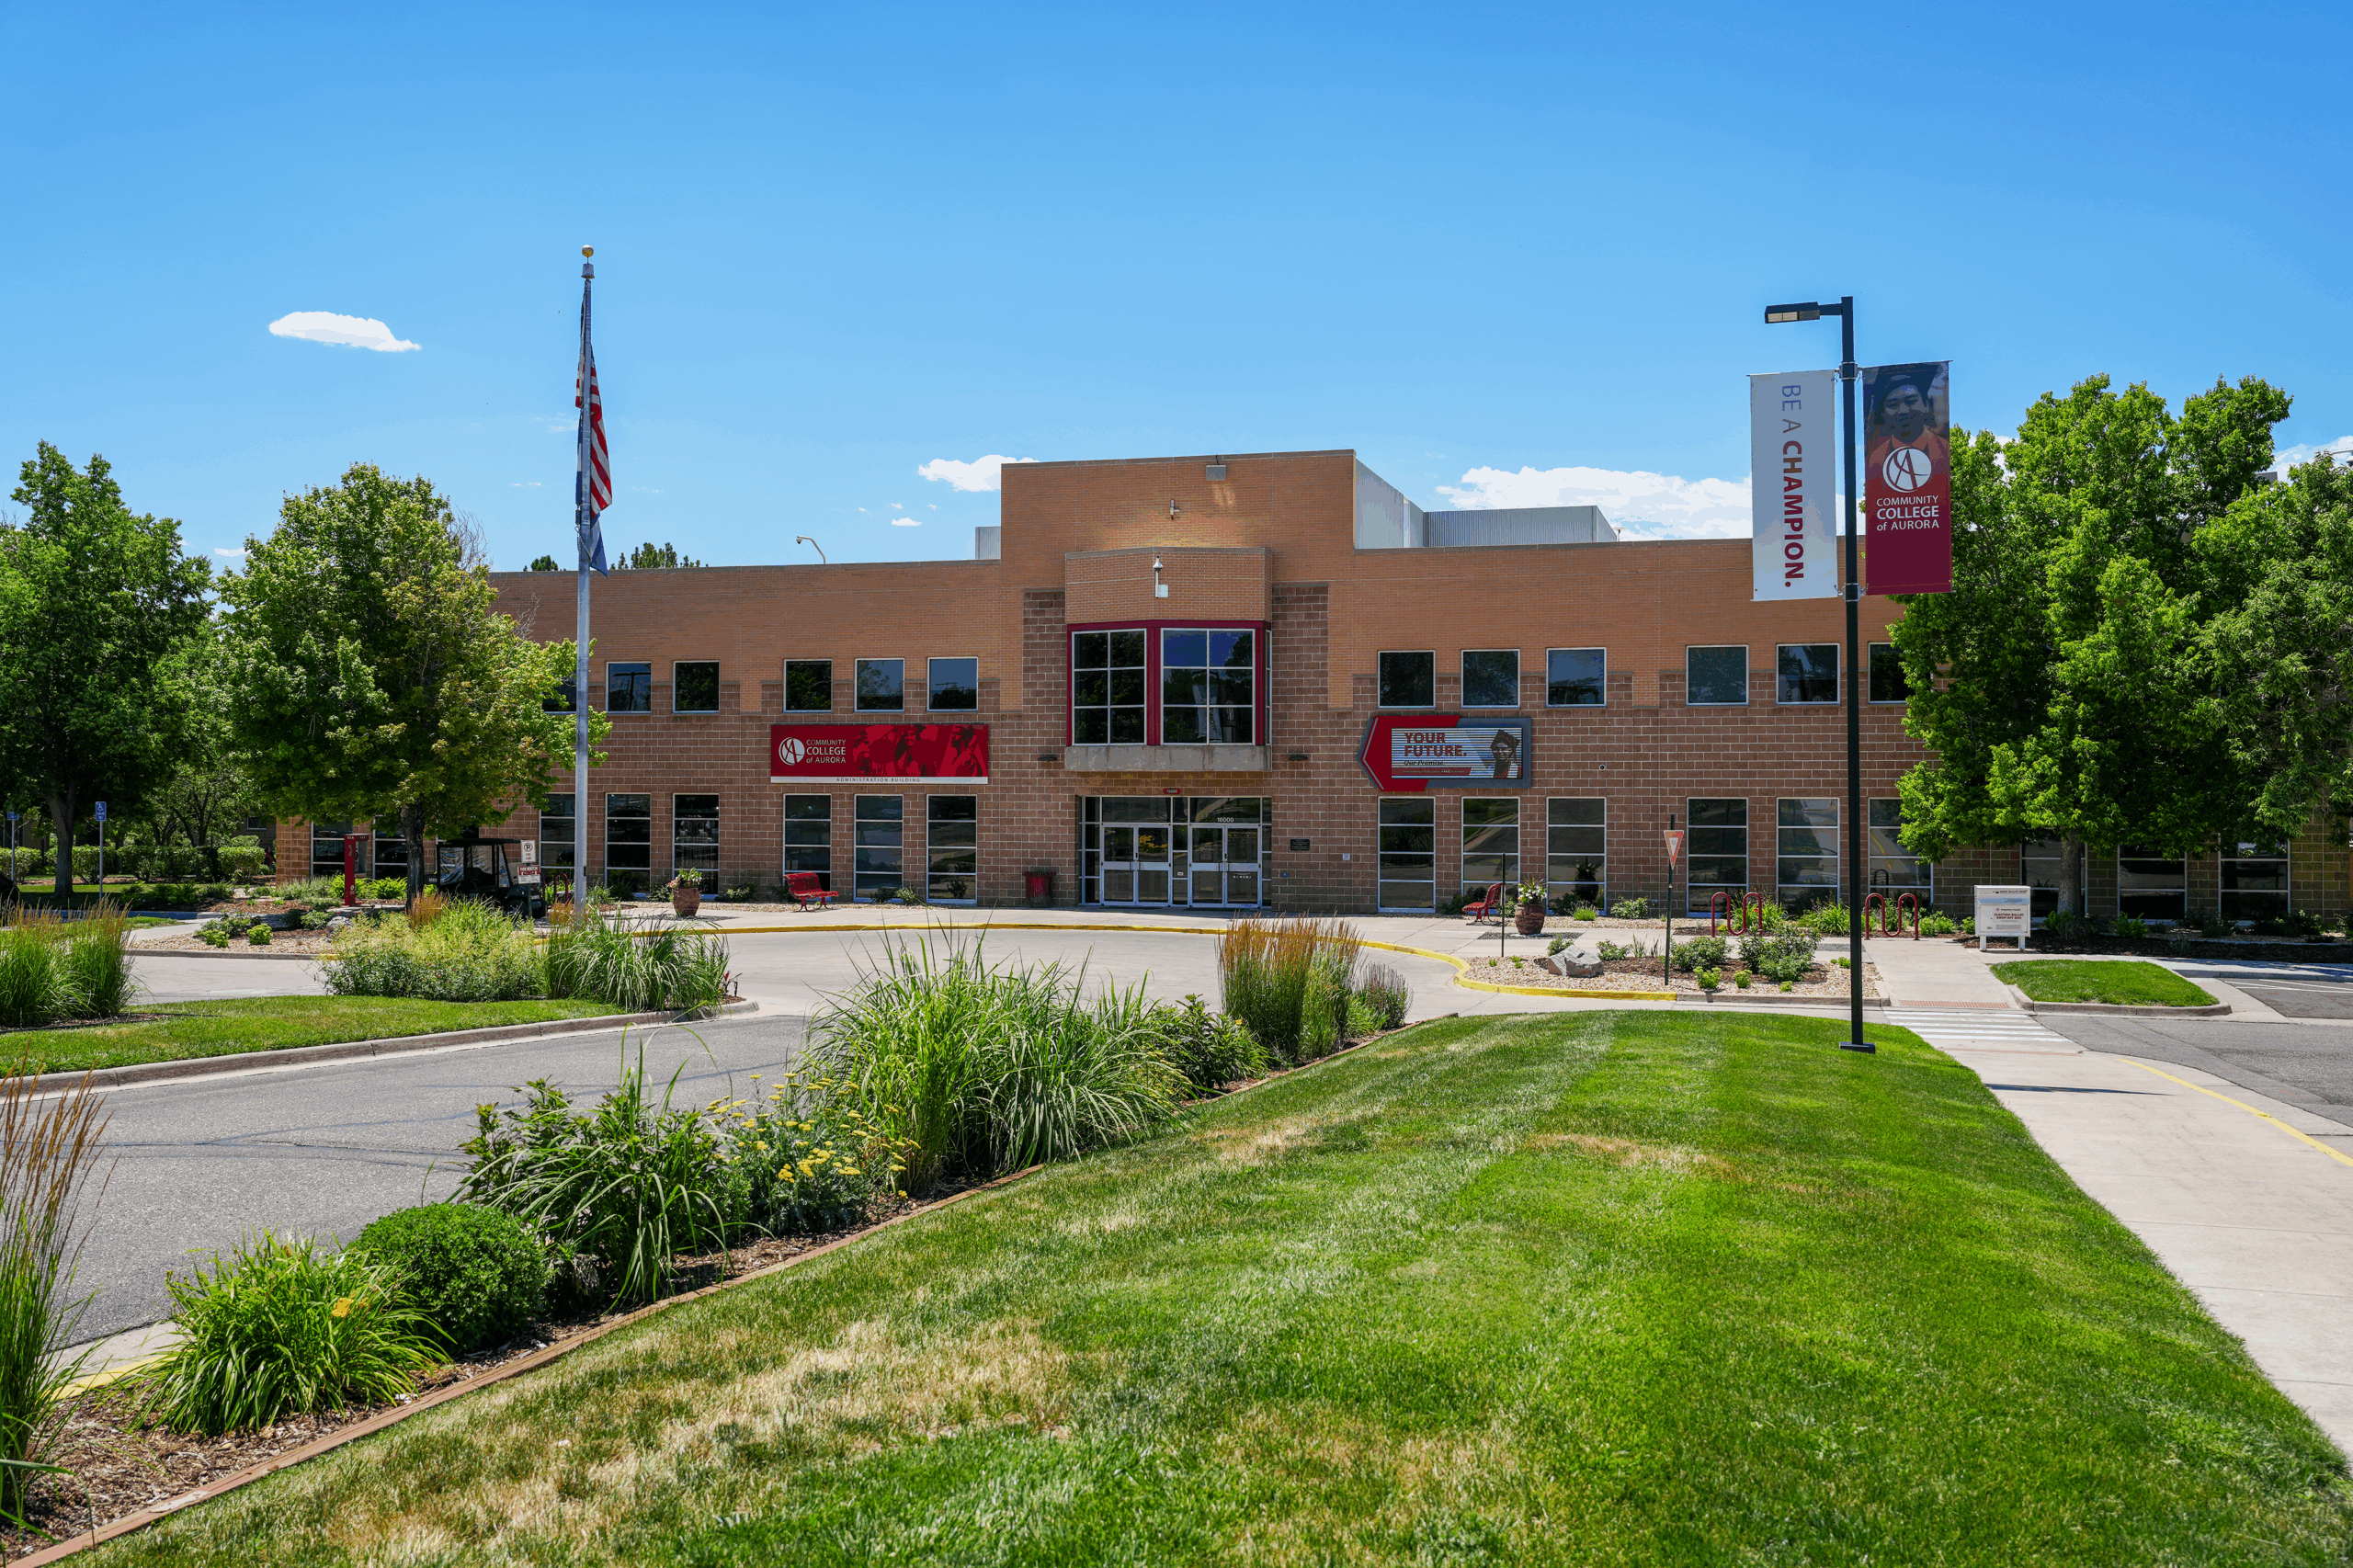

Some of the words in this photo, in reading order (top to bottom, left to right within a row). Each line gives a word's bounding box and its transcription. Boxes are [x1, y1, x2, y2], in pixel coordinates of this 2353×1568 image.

[1782, 385, 1802, 411] BE
[1782, 418, 1802, 434] A
[1876, 495, 1939, 507] COMMUNITY
[1782, 440, 1804, 587] CHAMPION.
[1876, 506, 1939, 520] COLLEGE
[1876, 521, 1887, 531] of
[1891, 519, 1939, 530] AURORA
[1404, 733, 1446, 744] YOUR
[806, 746, 847, 755] COLLEGE
[1404, 745, 1468, 756] FUTURE.
